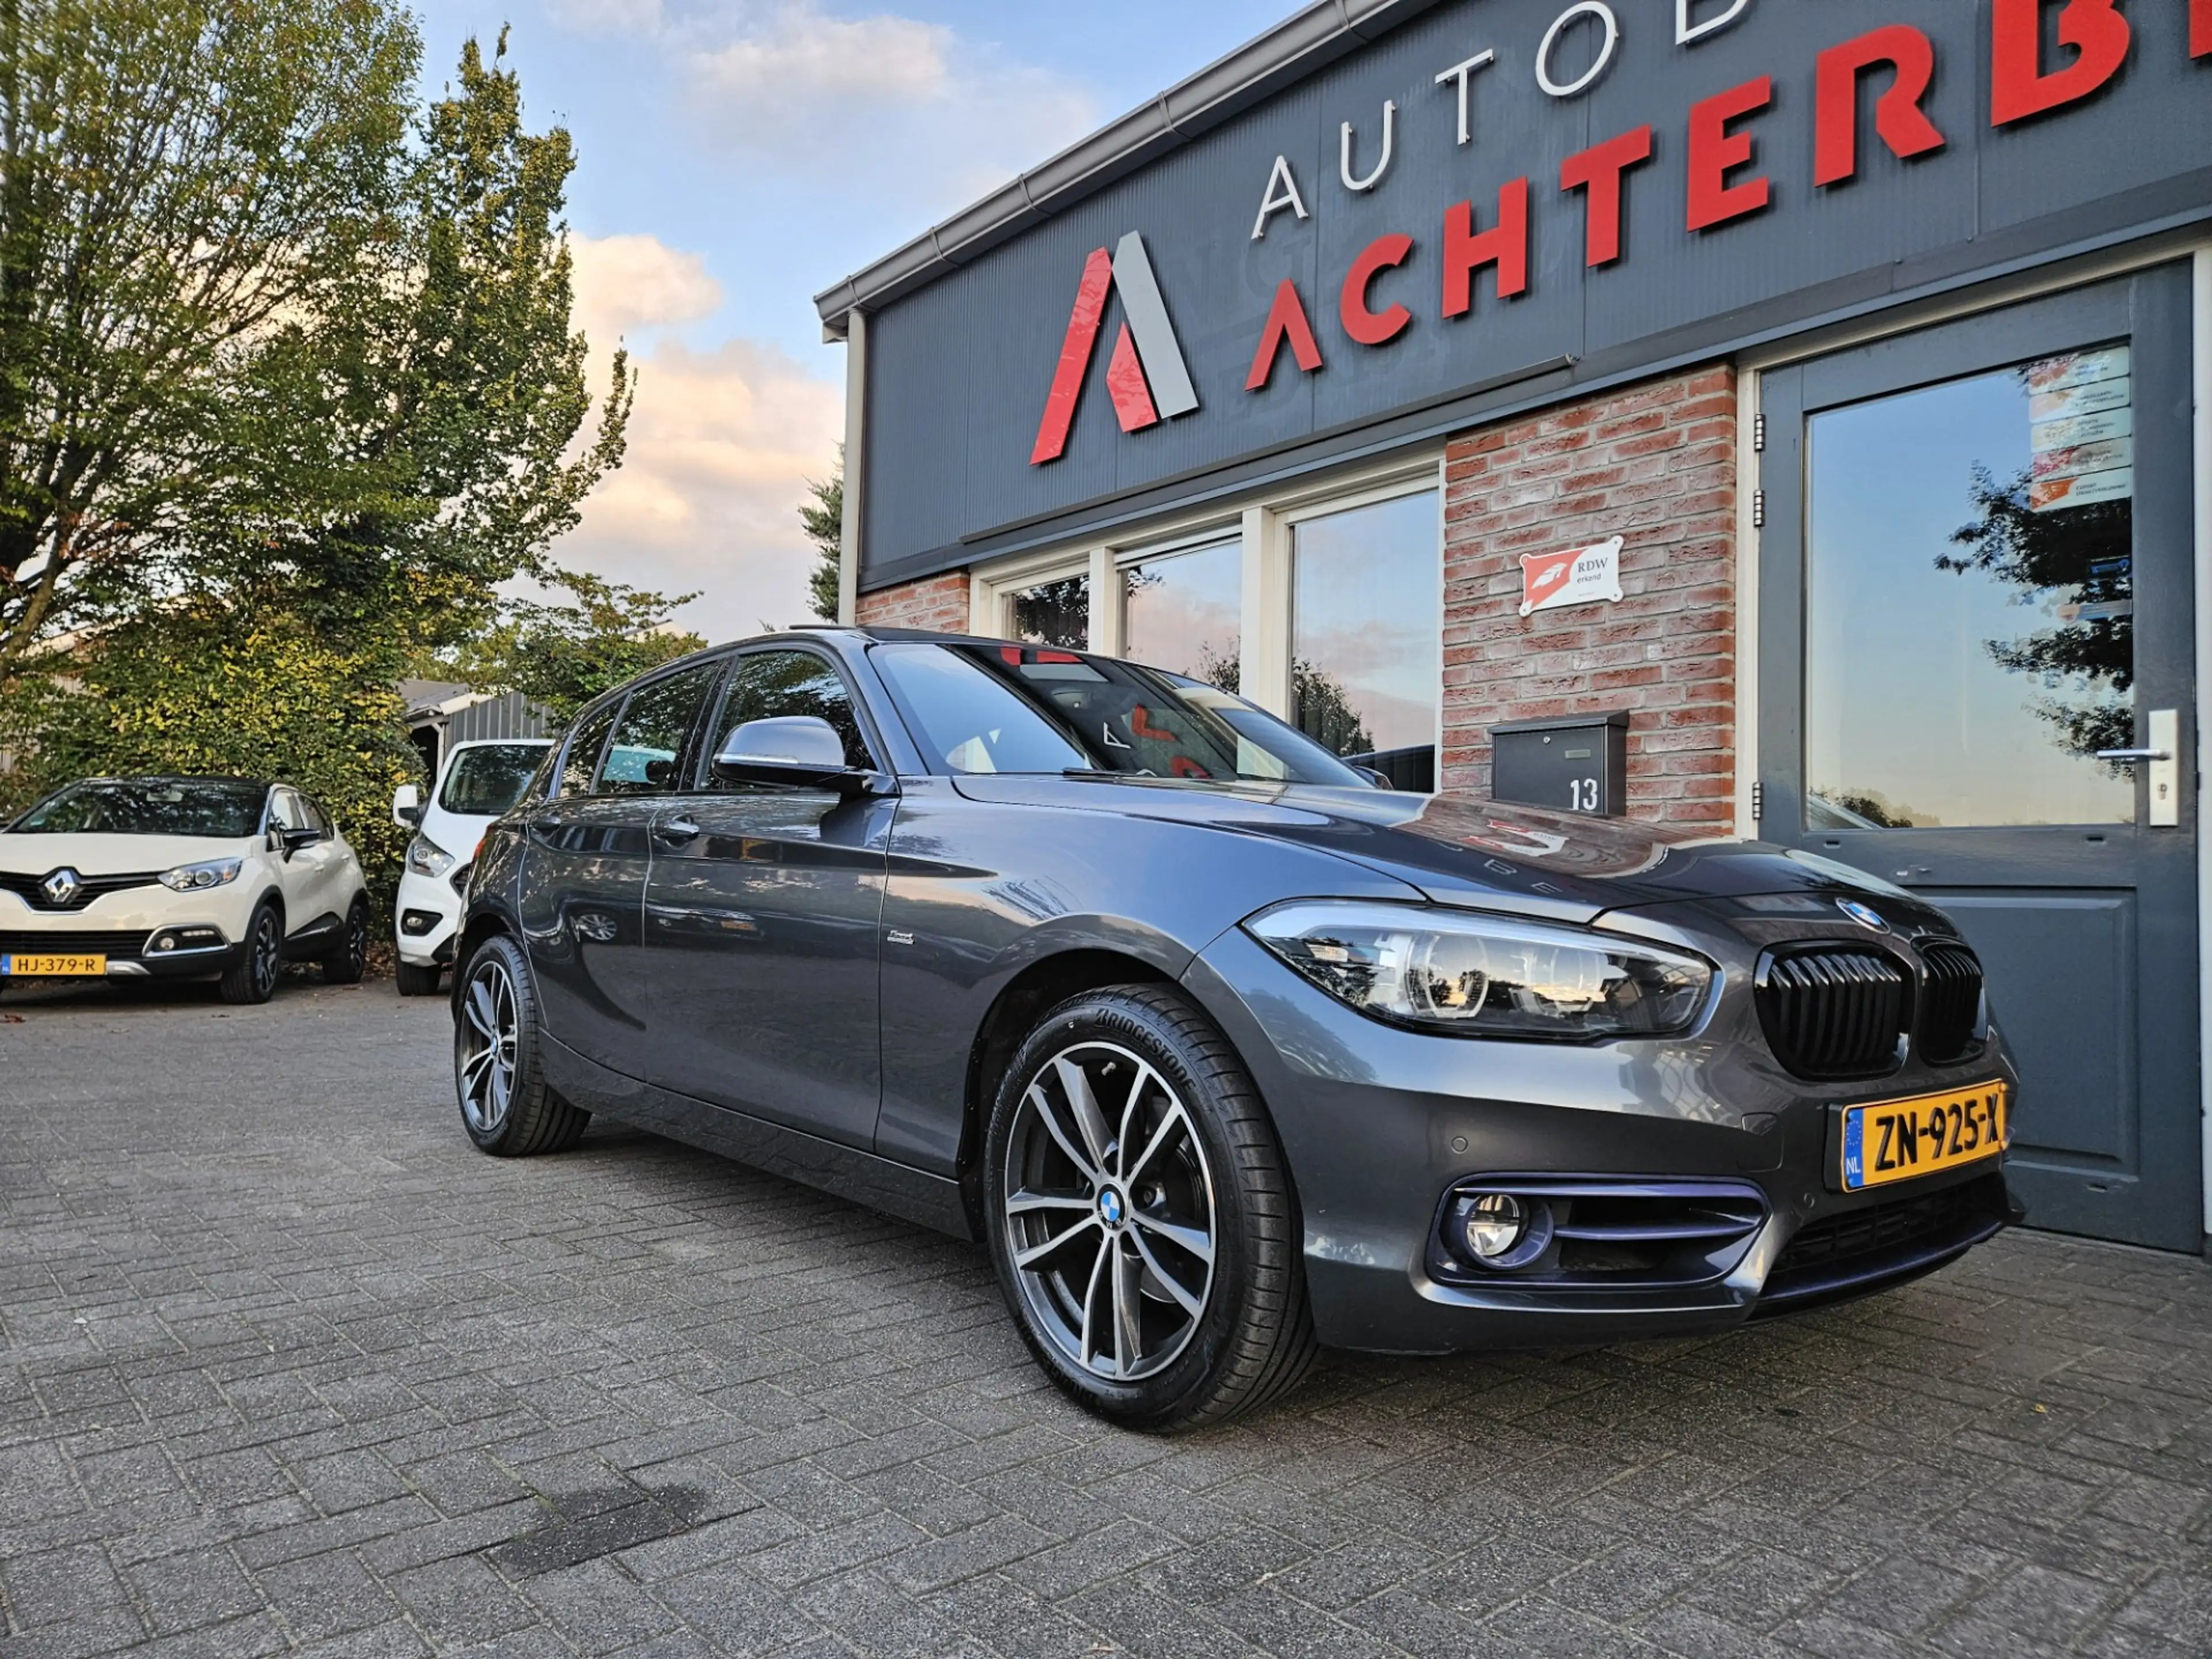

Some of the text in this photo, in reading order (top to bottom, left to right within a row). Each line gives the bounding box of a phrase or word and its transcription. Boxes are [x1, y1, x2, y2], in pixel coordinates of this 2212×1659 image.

[1245, 0, 2212, 392] ACHTERB
[1578, 558, 1608, 573] RDW
[1577, 573, 1601, 584] erkend
[1570, 778, 1597, 810] 13
[18, 958, 96, 972] HJ-379-R
[1875, 1093, 1999, 1172] ZN-925-X
[1846, 1156, 1861, 1175] NL
